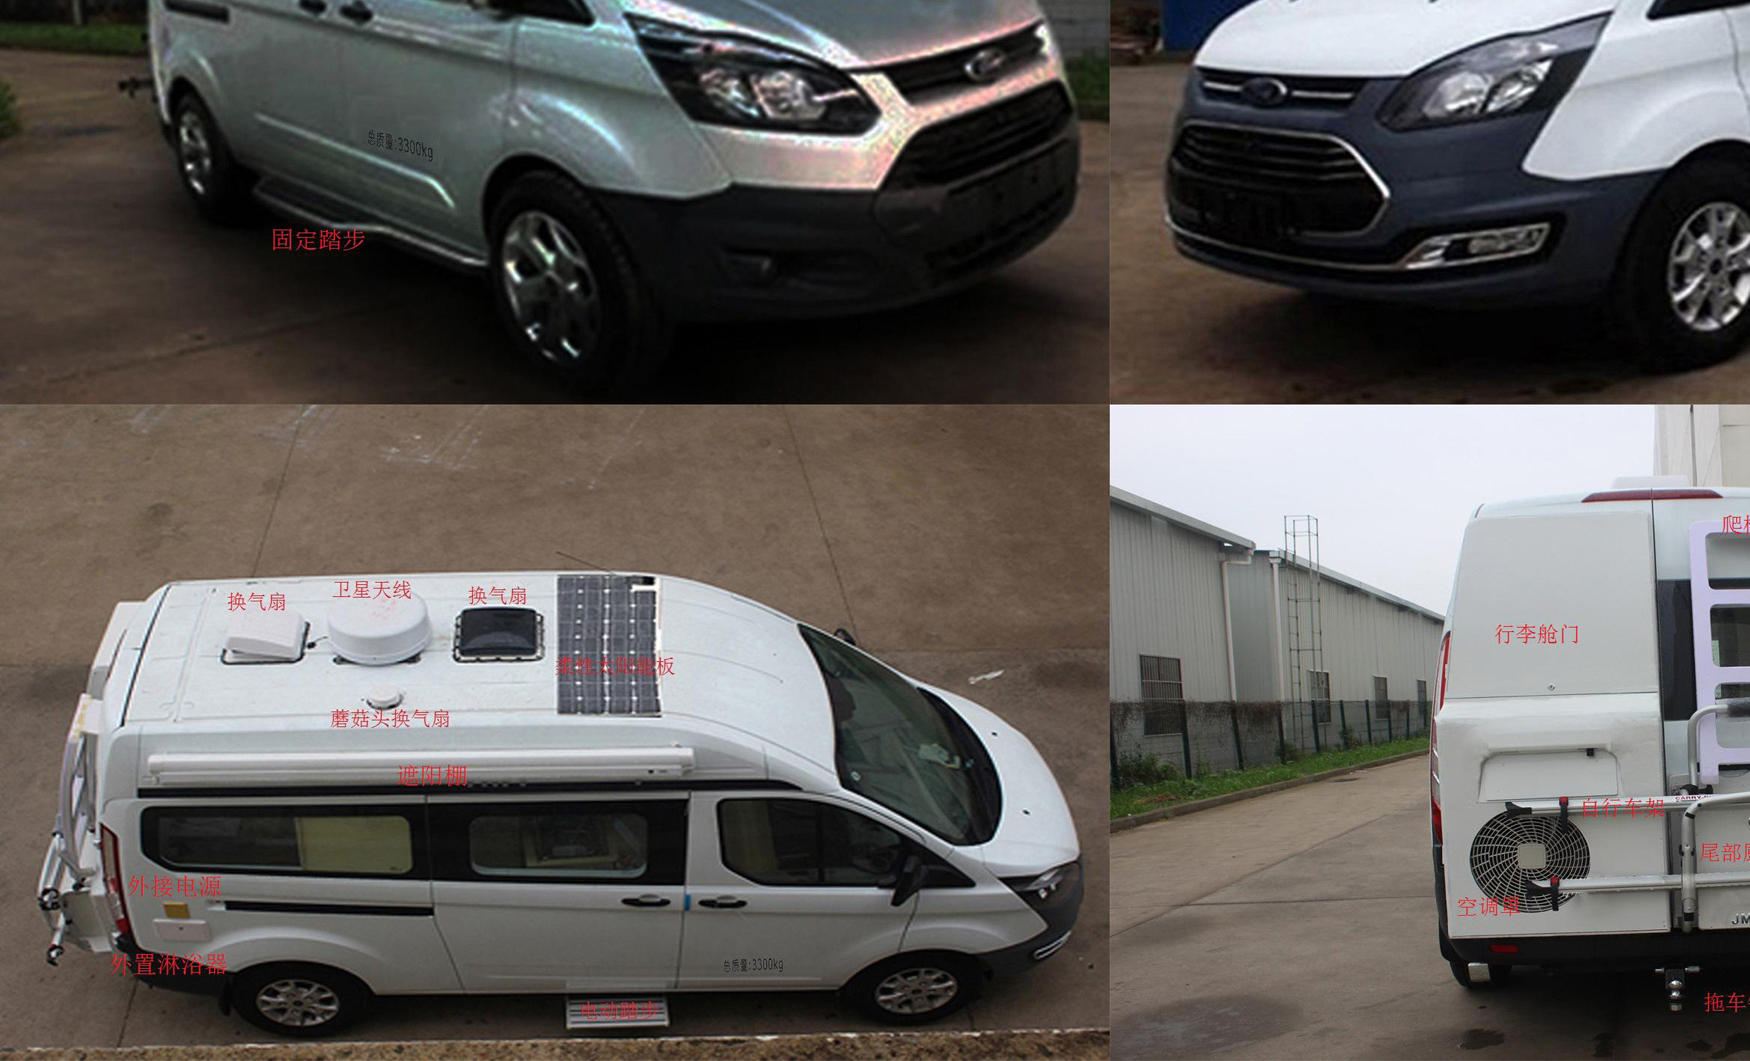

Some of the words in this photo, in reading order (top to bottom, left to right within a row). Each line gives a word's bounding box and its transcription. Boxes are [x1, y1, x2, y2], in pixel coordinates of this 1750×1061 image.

[367, 129, 434, 162] 总质量:3300kg
[723, 957, 784, 973] 总质量:3300kg
